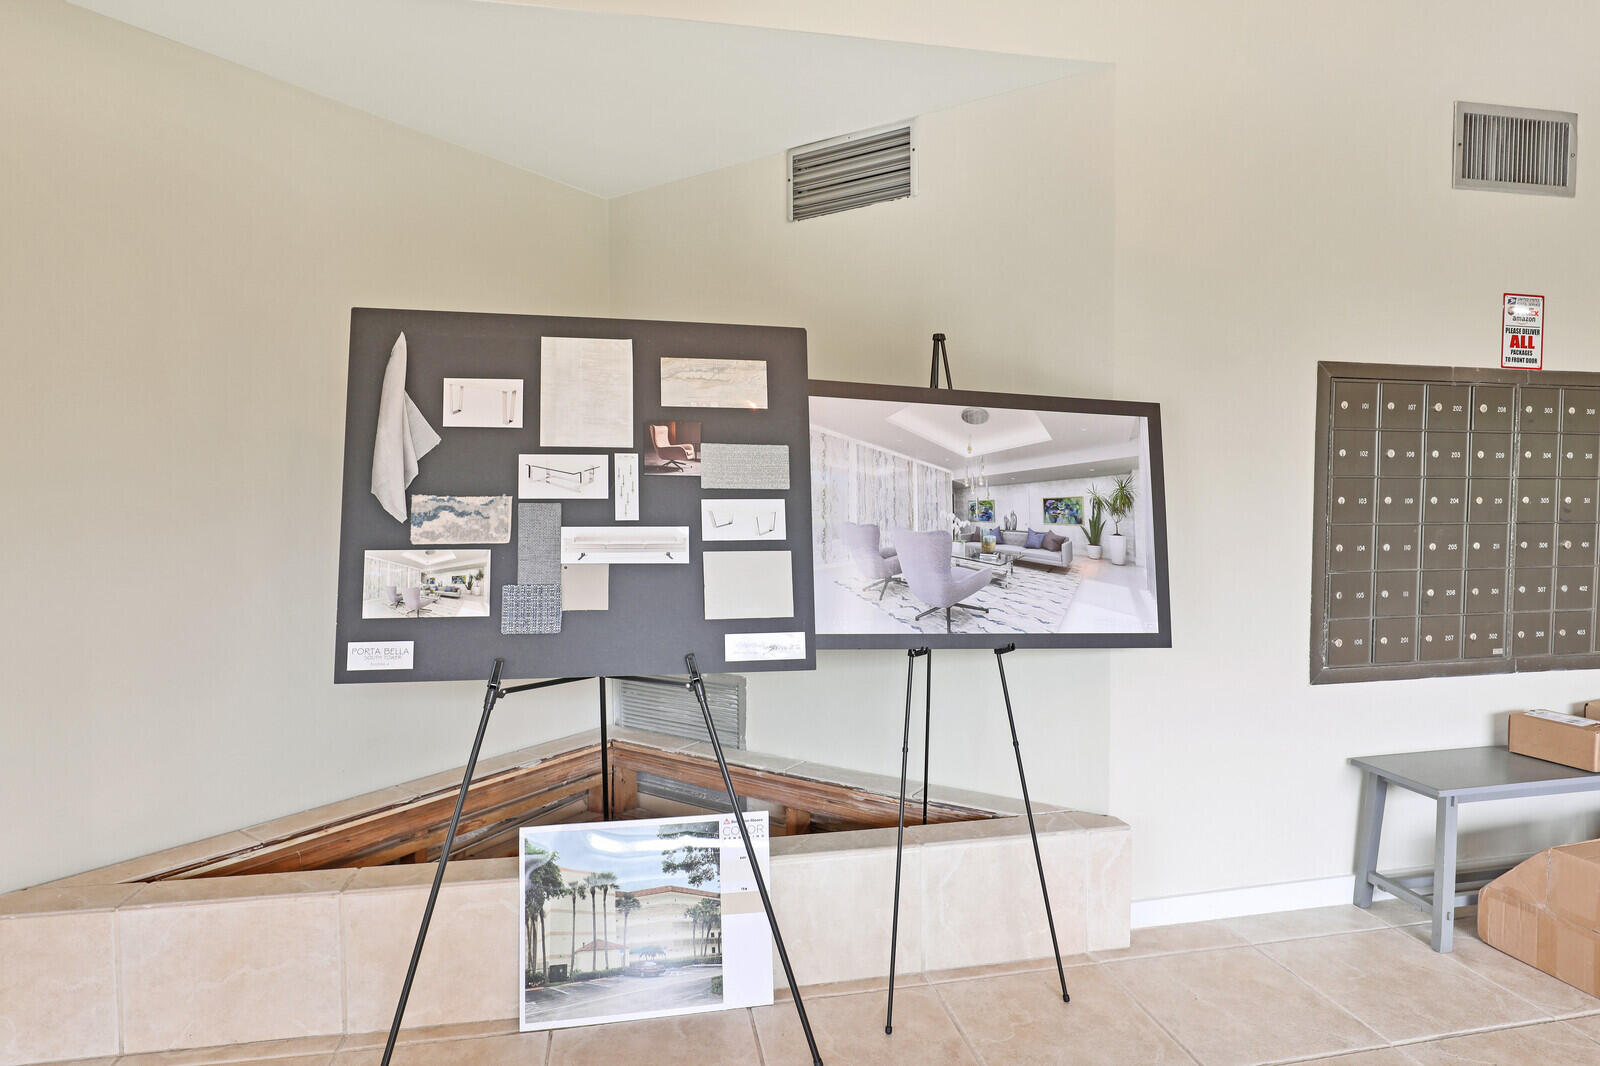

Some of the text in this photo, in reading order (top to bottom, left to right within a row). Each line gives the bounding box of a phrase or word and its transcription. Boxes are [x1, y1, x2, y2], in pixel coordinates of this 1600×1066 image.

[1510, 335, 1535, 349] ALL
[352, 647, 409, 655] PORTA BELLA
[723, 824, 764, 837] COOR
